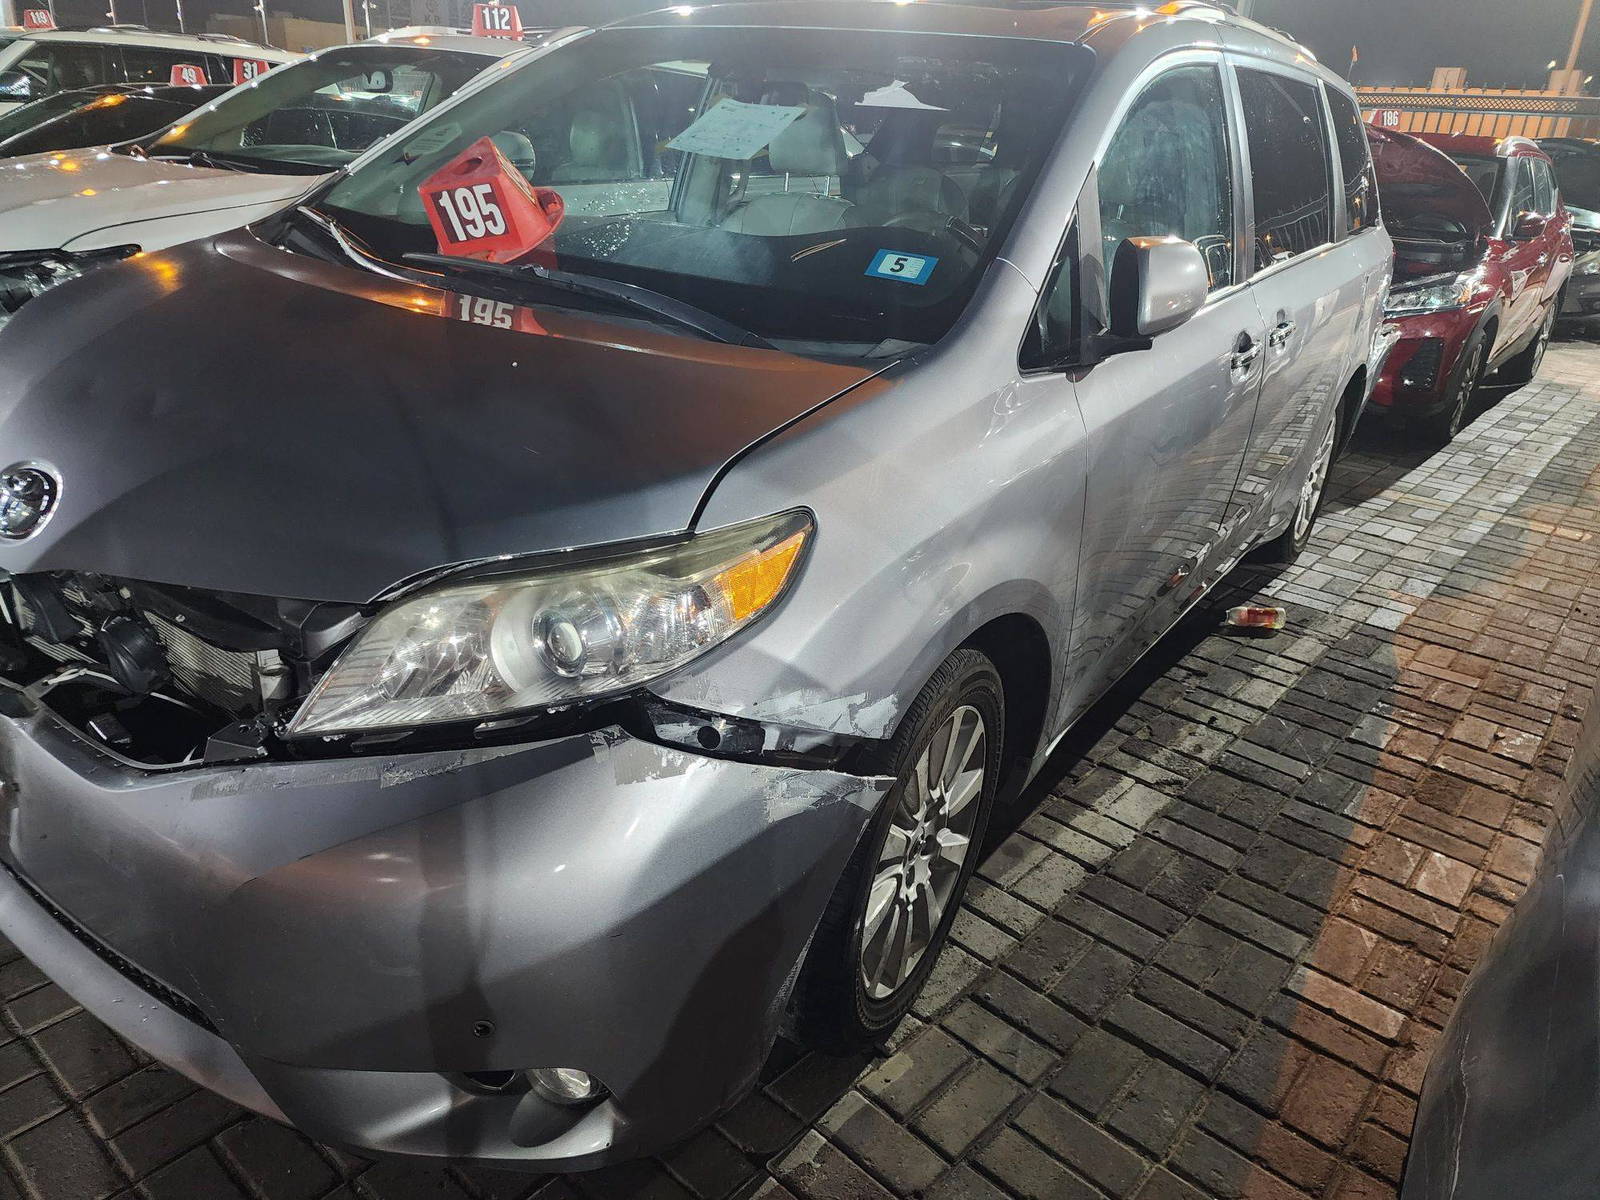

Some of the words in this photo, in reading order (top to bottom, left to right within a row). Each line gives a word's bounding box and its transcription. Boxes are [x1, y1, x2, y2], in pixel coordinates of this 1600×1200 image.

[482, 7, 511, 30] 112
[182, 67, 198, 84] 49
[243, 61, 258, 80] 31
[1382, 110, 1399, 126] 186
[438, 183, 506, 242] 195
[889, 257, 908, 272] 5
